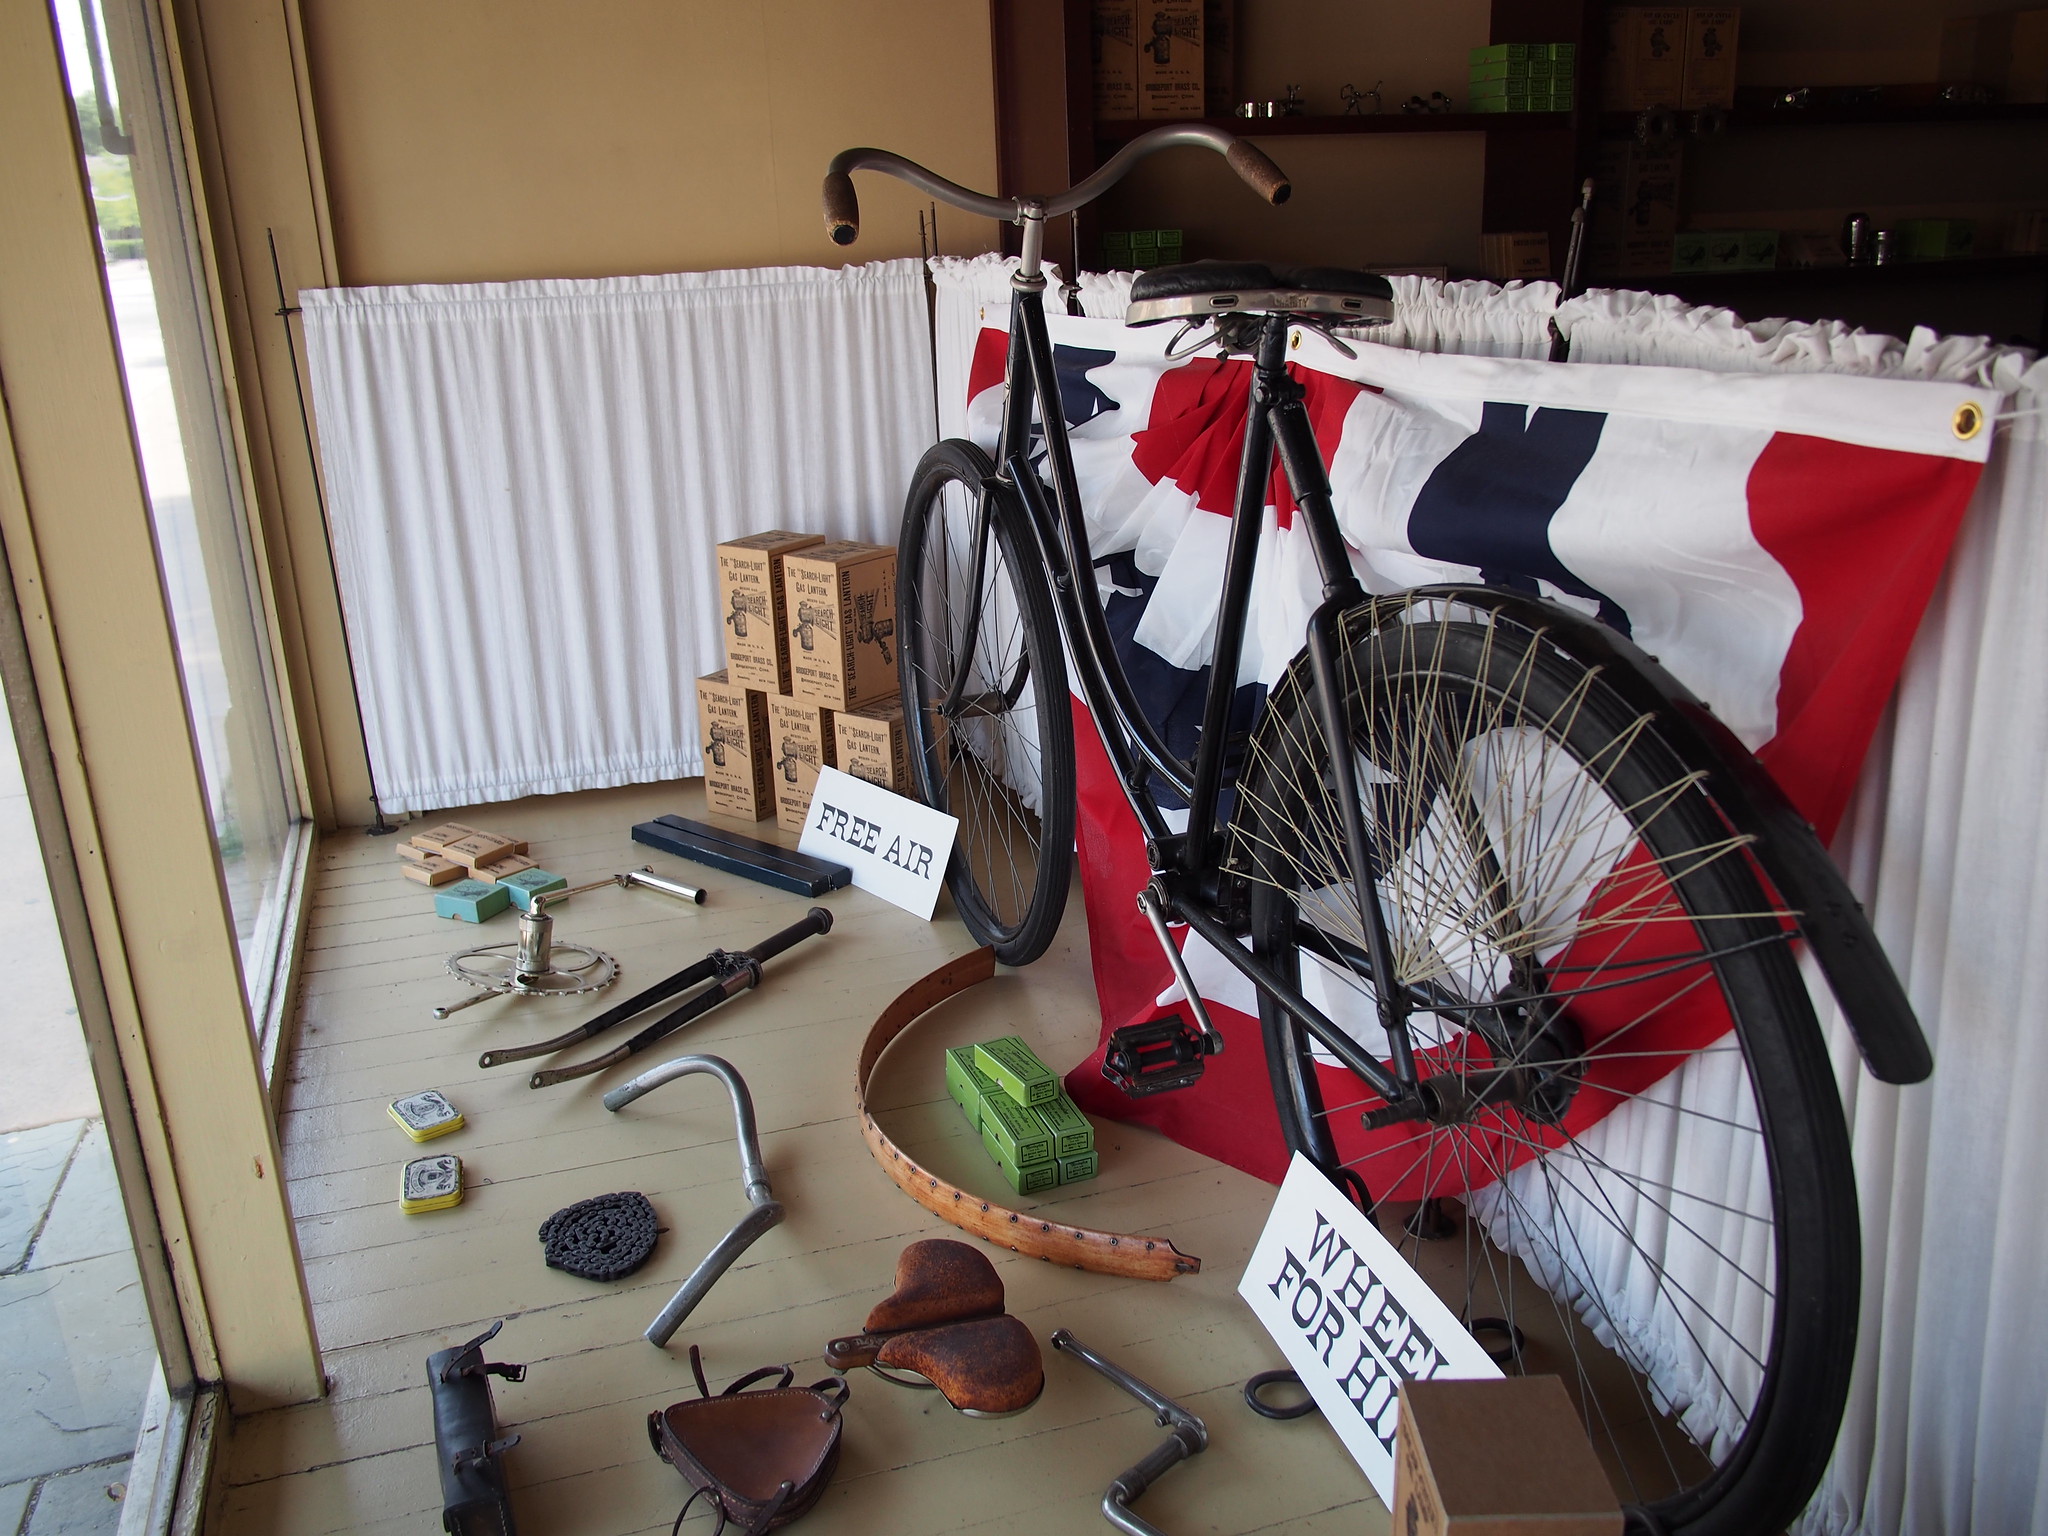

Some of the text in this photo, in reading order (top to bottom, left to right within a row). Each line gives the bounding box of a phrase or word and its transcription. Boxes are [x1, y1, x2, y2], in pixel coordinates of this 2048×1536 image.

[720, 556, 729, 567] THE
[728, 570, 738, 581] GAS
[773, 557, 784, 594] LANTERN
[787, 566, 797, 578] THE
[795, 581, 806, 593] GAS
[841, 570, 852, 607] LANTERN
[776, 594, 785, 611] GAS
[844, 608, 852, 625] GAS
[753, 654, 765, 665] BRASS
[795, 666, 817, 677] BRIDGEPORT
[818, 669, 832, 680] BRASS
[699, 690, 708, 700] THE
[849, 684, 857, 700] THE
[707, 703, 717, 714] GAS
[771, 703, 780, 714] THE
[779, 718, 789, 729] GAS
[838, 724, 847, 735] THE
[846, 739, 857, 750] GAS
[895, 729, 905, 783] GAS LANTERN
[731, 783, 742, 794] BRASS
[815, 801, 934, 881] FREE AIR
[1267, 1246, 1399, 1458] FOR HI
